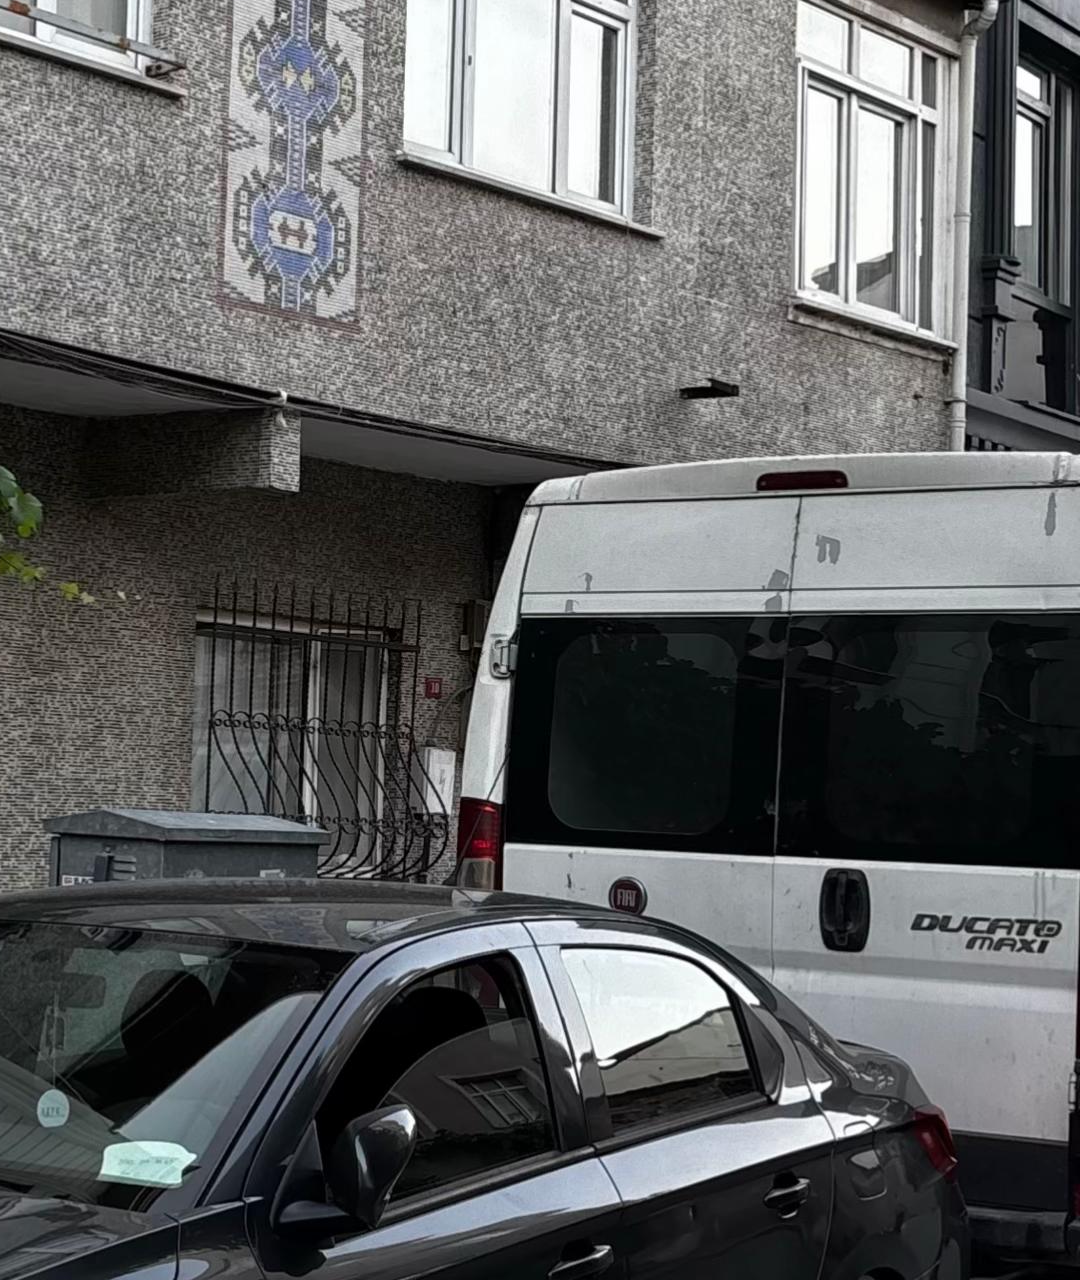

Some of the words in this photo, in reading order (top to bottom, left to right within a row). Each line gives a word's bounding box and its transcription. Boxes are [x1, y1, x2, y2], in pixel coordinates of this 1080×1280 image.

[616, 888, 637, 907] FIAT
[910, 913, 1063, 938] DUCATO
[965, 936, 1050, 954] MAXI
